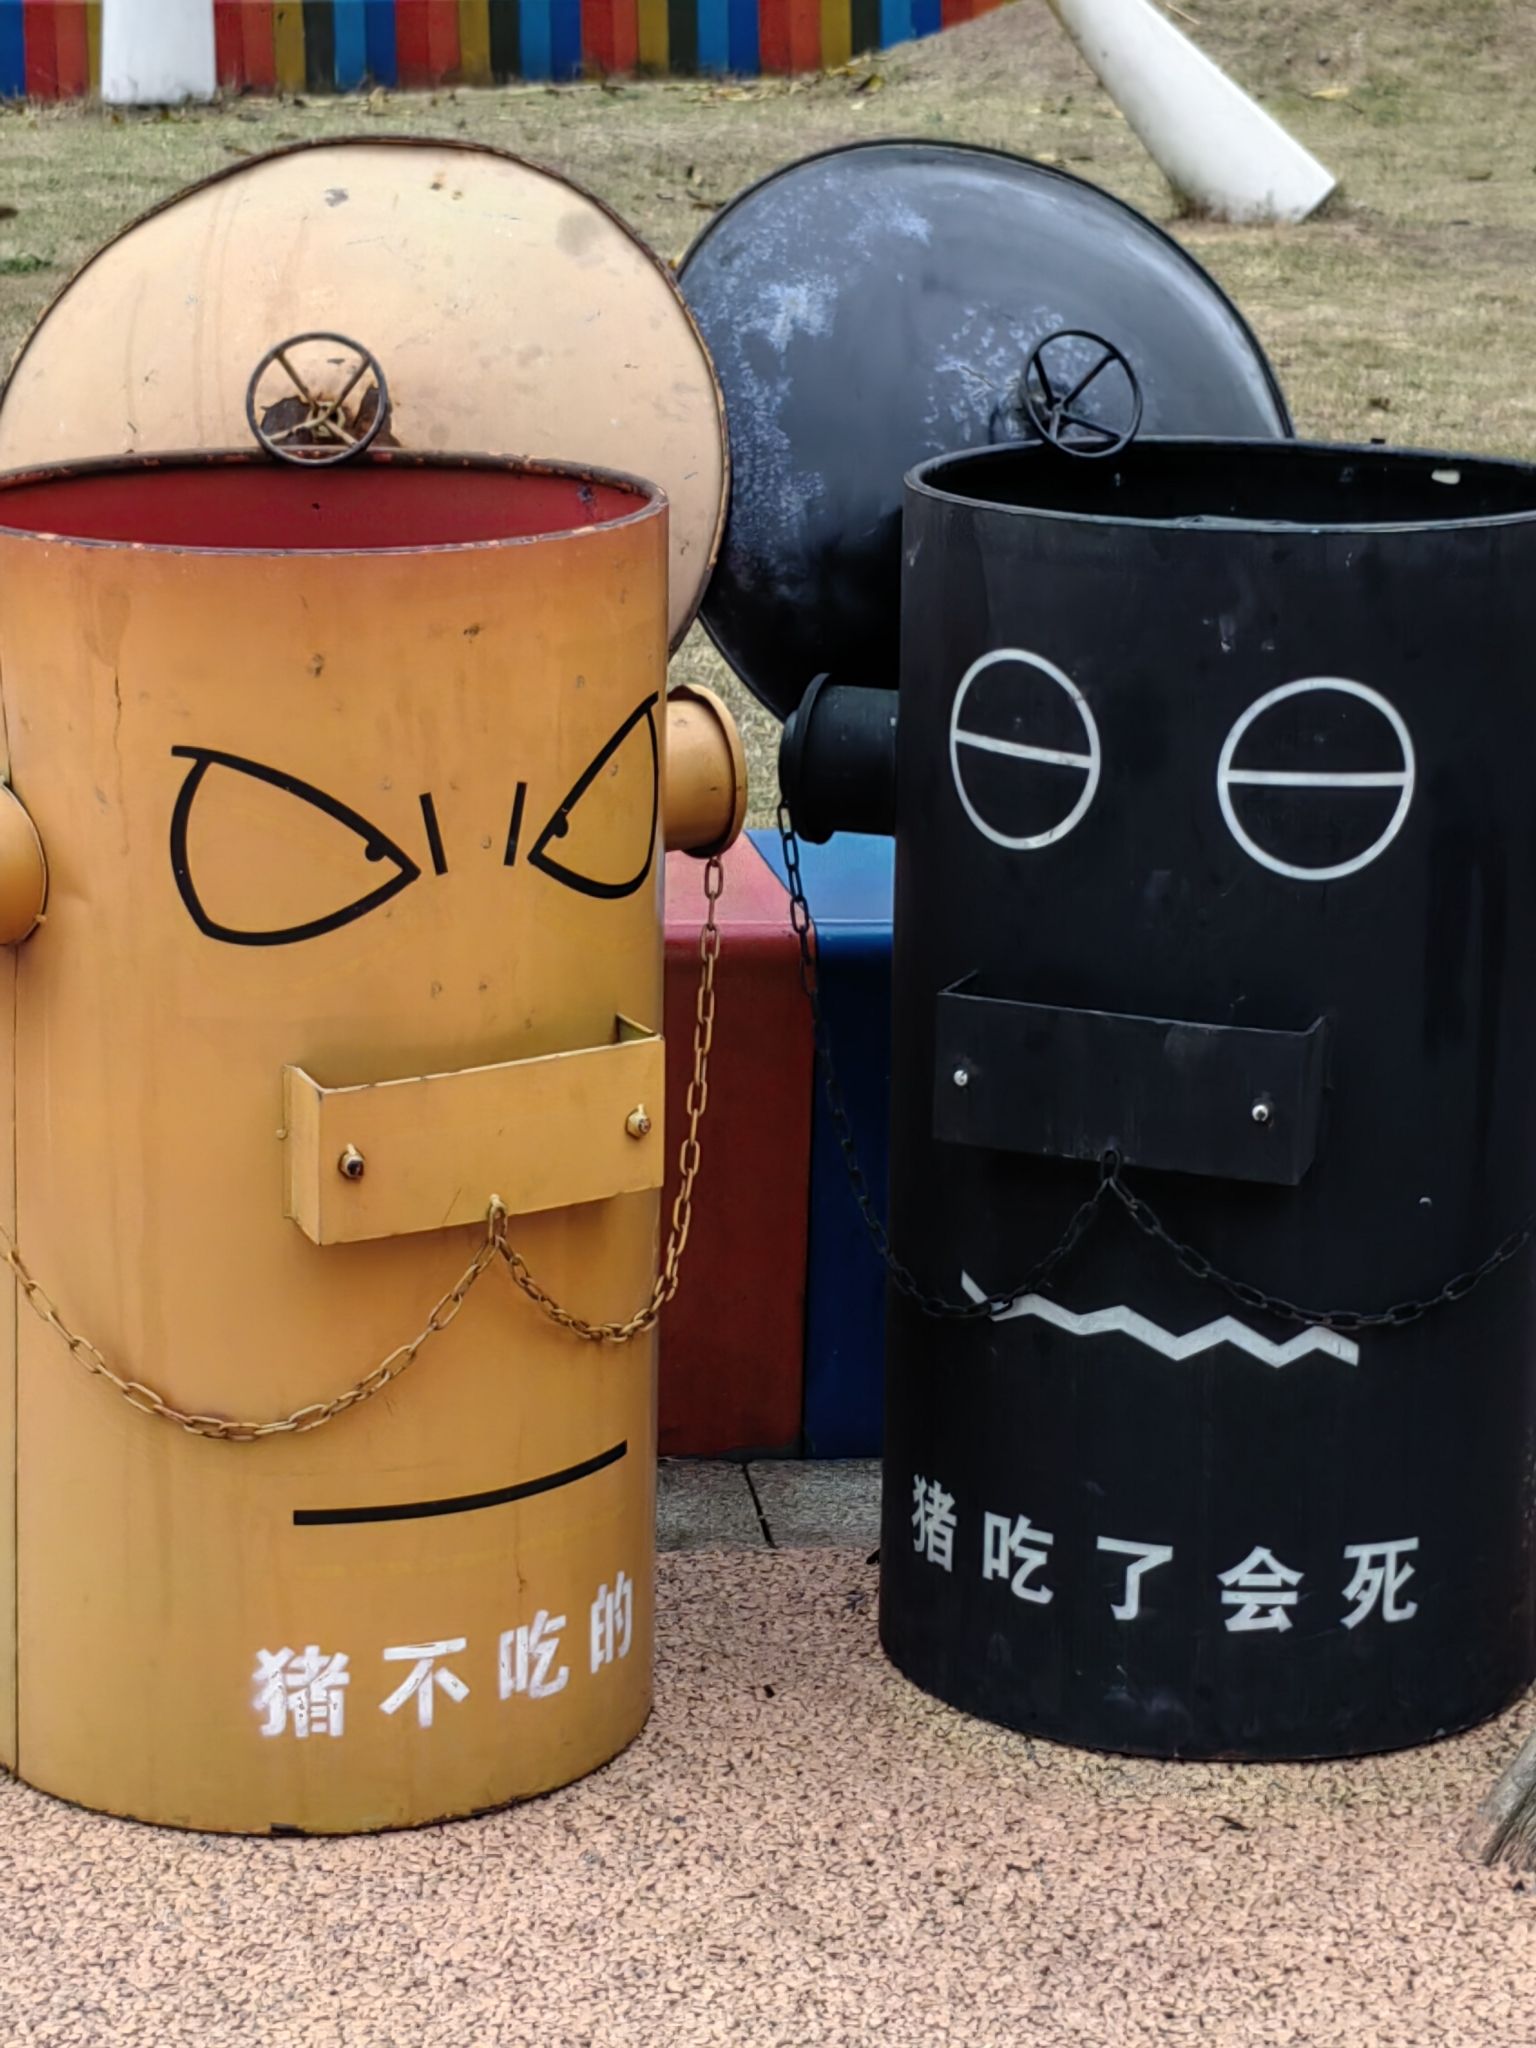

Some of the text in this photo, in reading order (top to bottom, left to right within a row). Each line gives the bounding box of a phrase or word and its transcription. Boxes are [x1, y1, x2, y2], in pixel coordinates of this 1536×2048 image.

[911, 1474, 1420, 1633] 猪吃了会死
[251, 1570, 633, 1738] 猪不吃的
